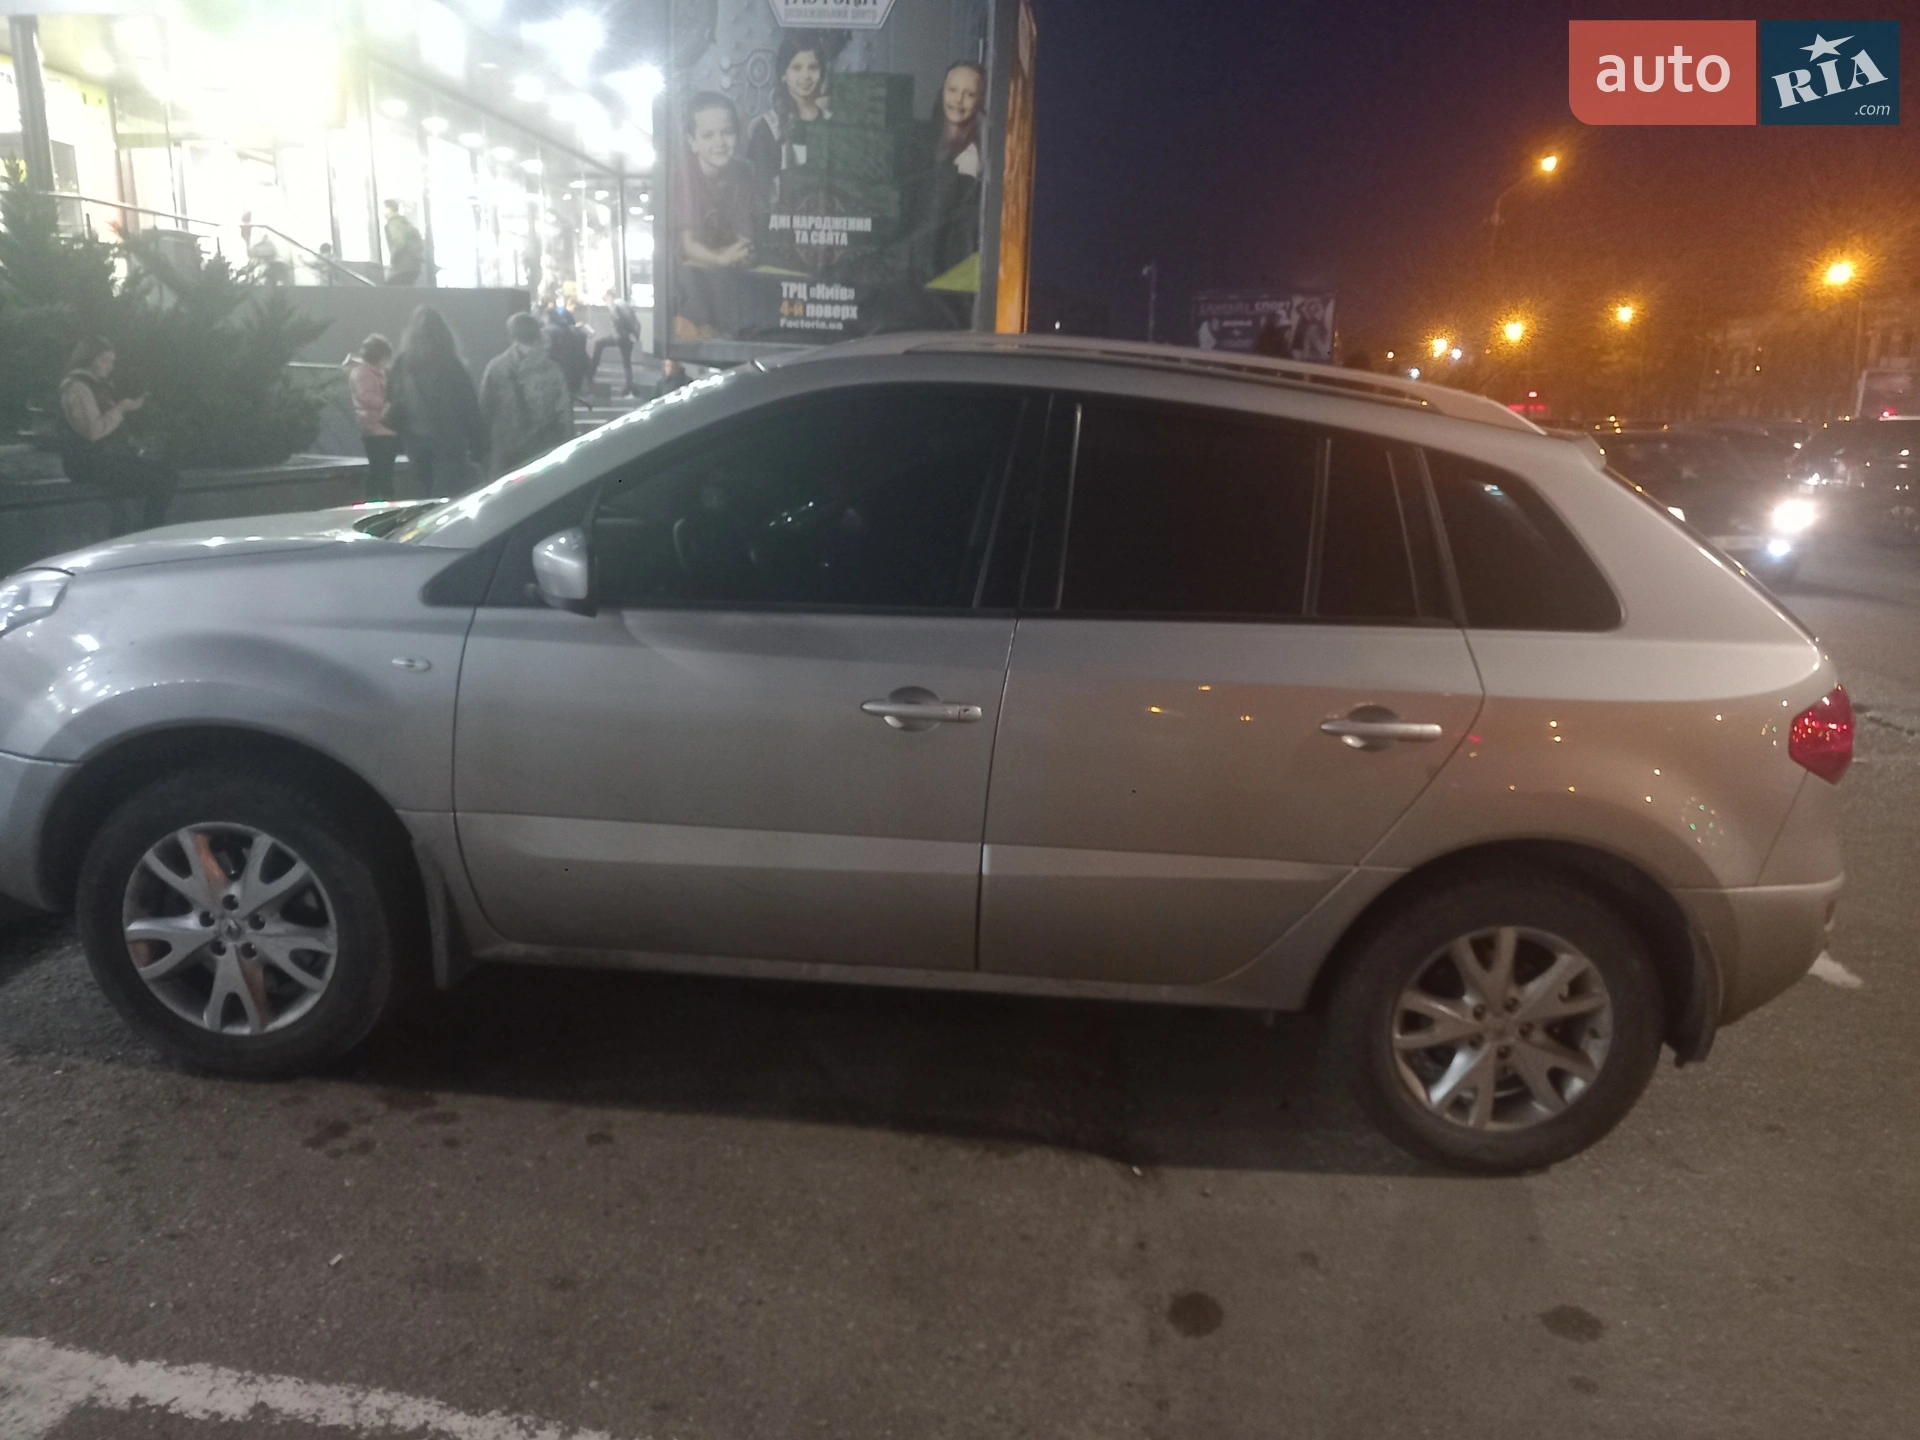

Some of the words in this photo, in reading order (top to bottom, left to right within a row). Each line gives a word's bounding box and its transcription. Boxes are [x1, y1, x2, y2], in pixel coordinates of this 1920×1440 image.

[792, 215, 872, 232] НАРОДЖЕННЯ
[794, 230, 808, 244] ТА
[810, 231, 848, 246] СВЯТА
[781, 282, 807, 301] ТРЦ
[806, 303, 858, 320] поверх
